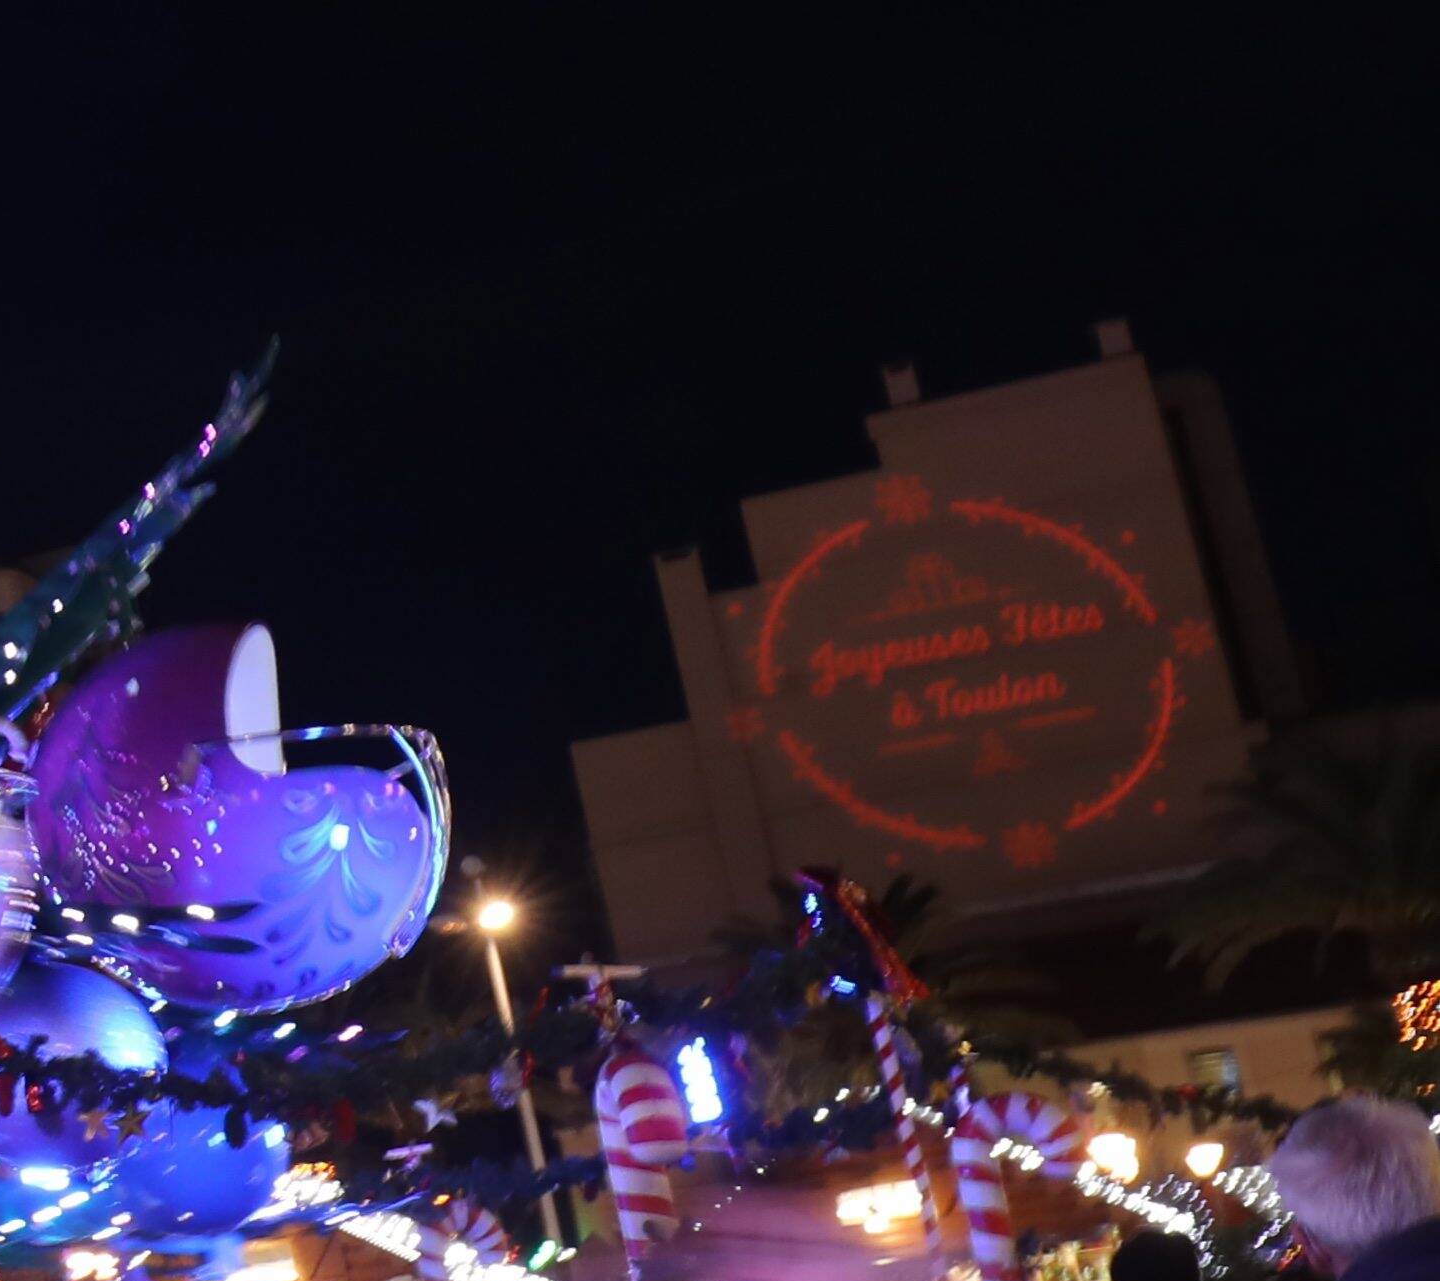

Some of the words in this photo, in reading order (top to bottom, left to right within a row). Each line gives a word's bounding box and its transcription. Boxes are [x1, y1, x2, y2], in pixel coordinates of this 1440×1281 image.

[808, 624, 991, 699] Joyeuses
[999, 602, 1105, 647] Fêtes
[890, 689, 924, 729] à
[925, 671, 1068, 721] Toulon
